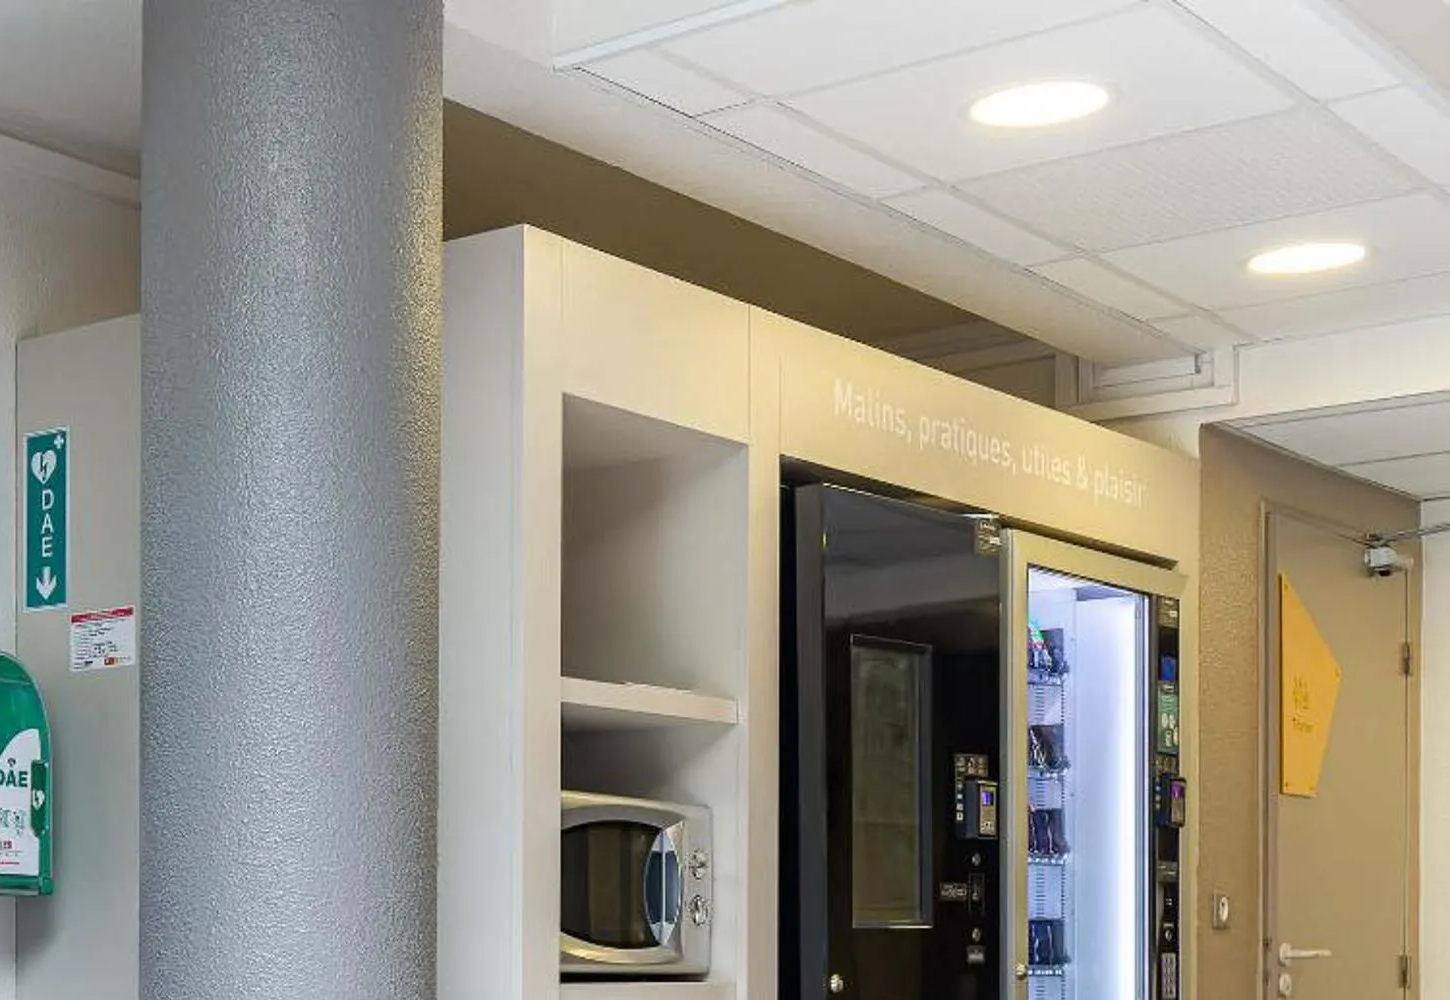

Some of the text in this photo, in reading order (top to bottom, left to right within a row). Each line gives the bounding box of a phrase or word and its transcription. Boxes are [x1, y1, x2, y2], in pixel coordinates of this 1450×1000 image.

[834, 379, 912, 444] Malins,
[919, 413, 1017, 475] pratiques,
[1022, 443, 1072, 486] utiles
[1076, 454, 1090, 490] &
[41, 488, 55, 558] DAE
